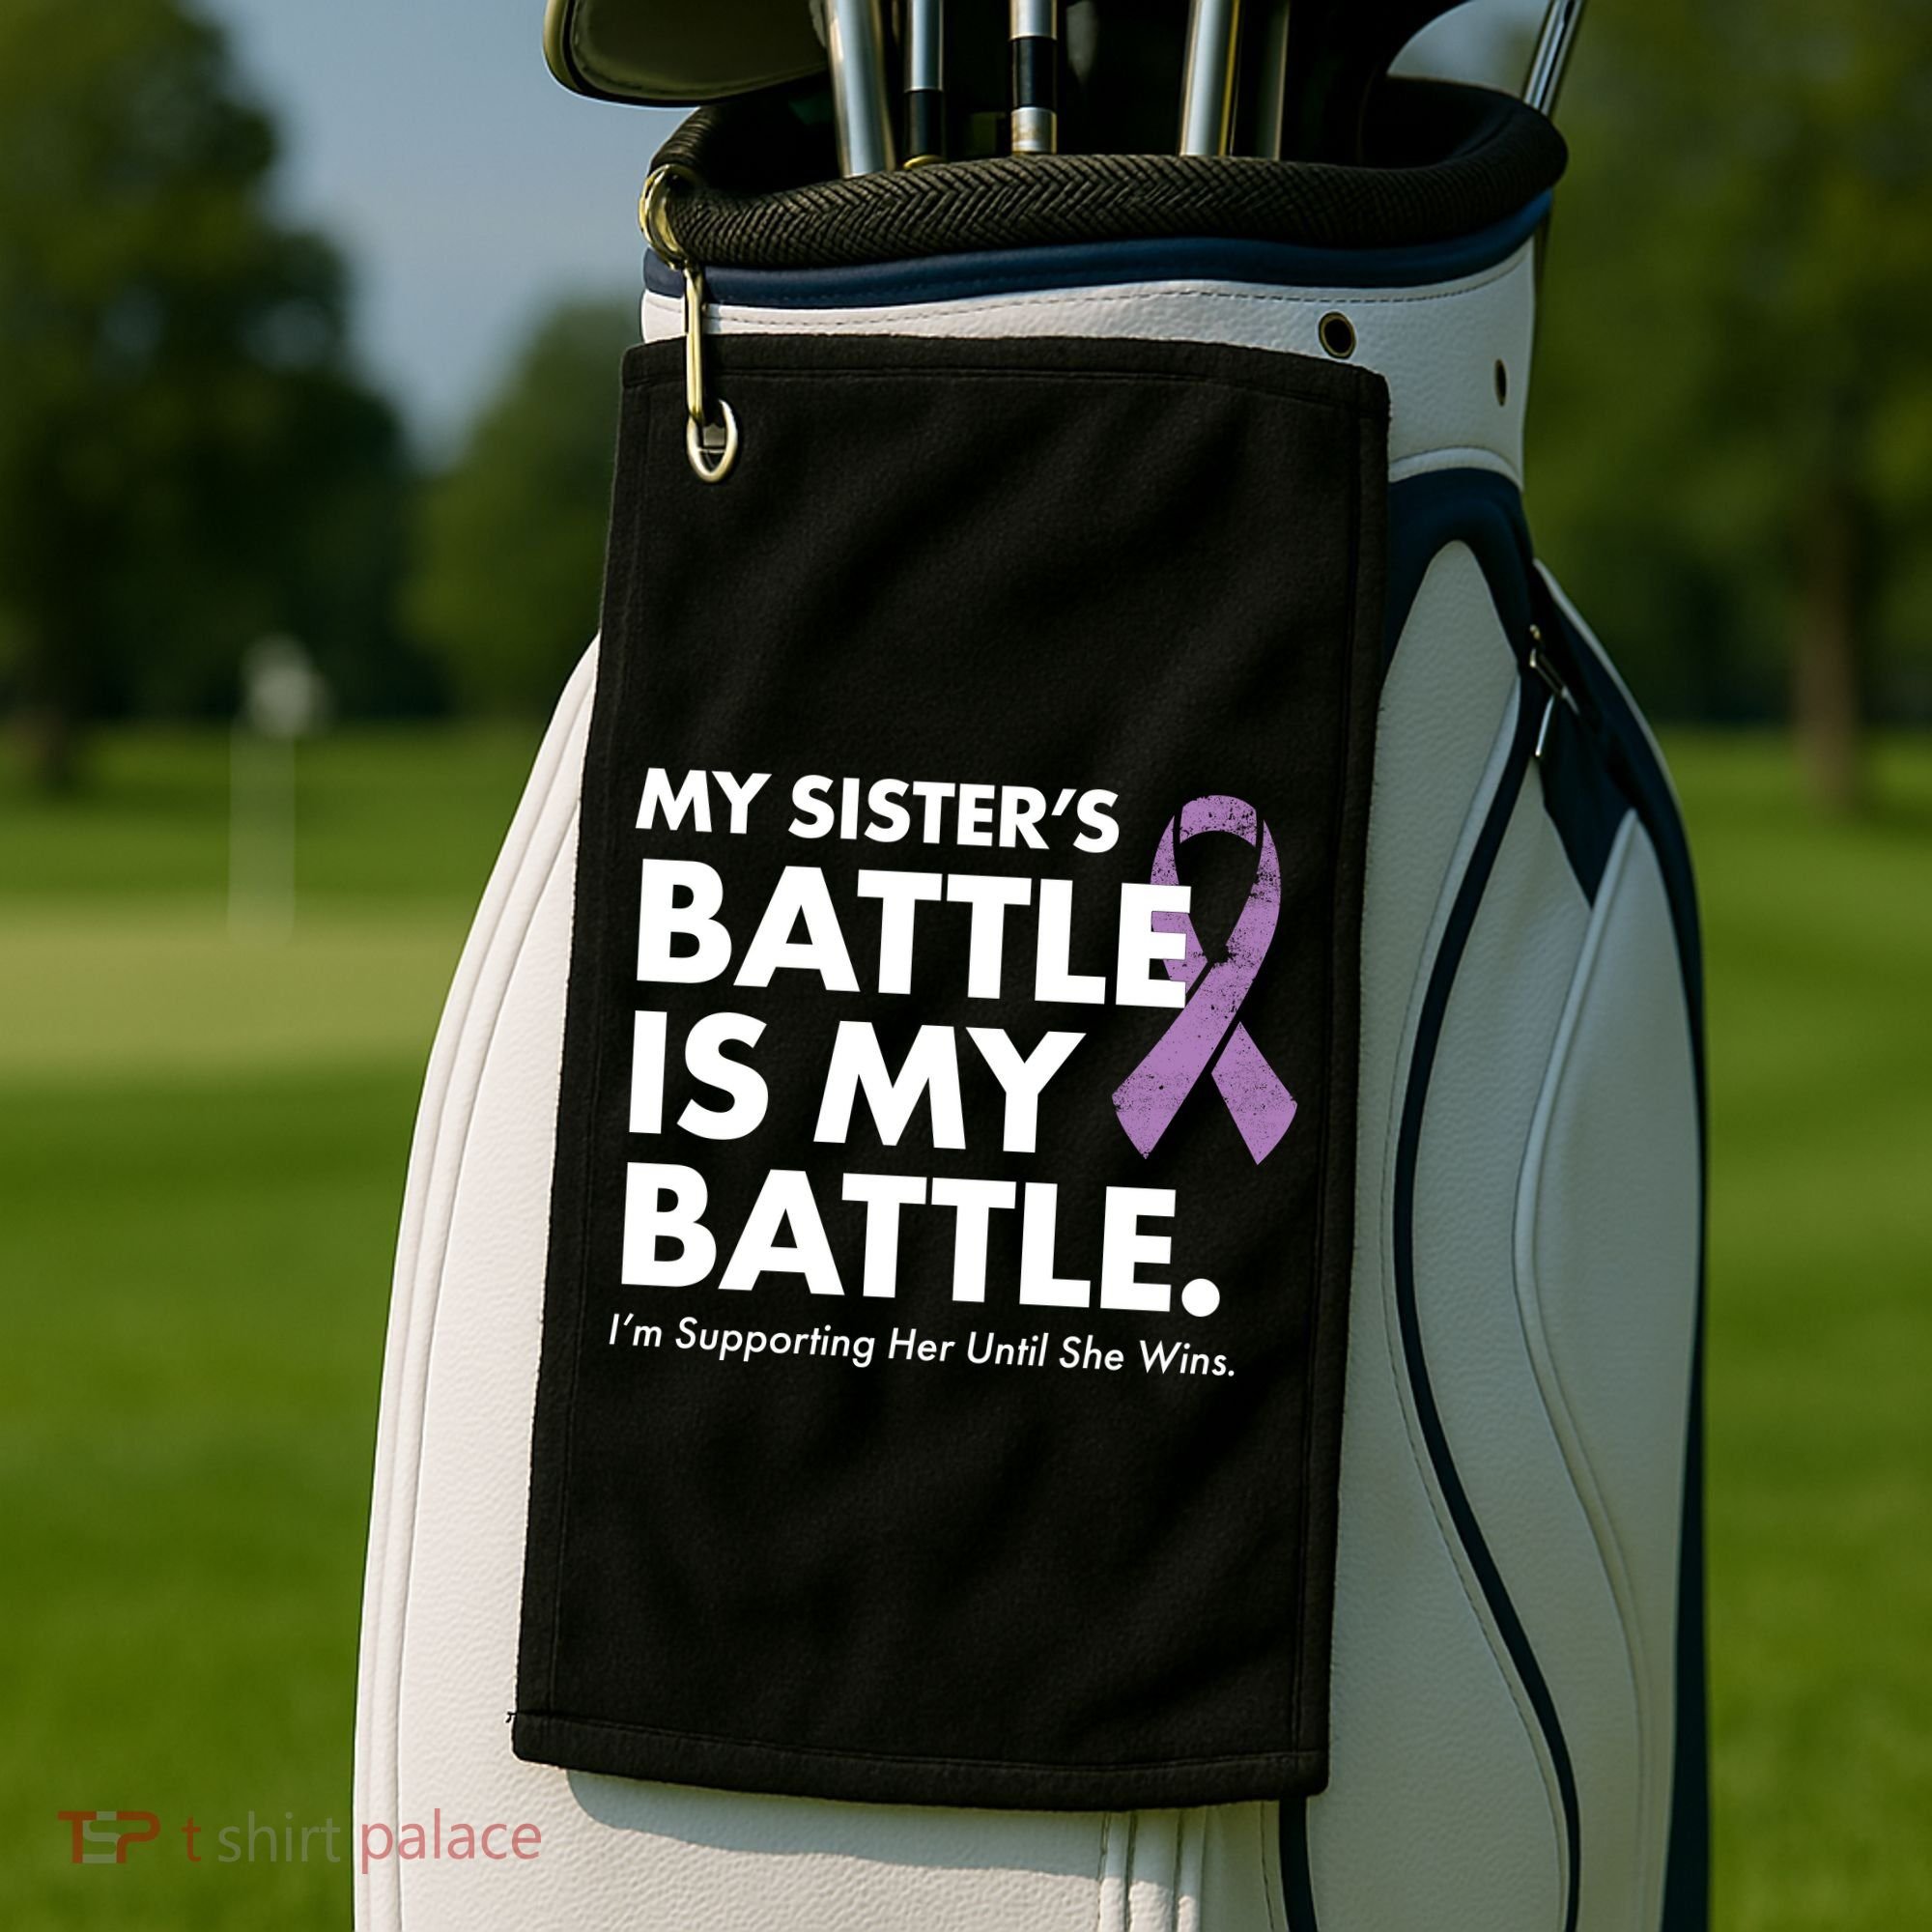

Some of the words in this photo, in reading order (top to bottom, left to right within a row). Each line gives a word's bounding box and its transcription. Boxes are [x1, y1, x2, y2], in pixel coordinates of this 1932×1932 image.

[635, 767, 772, 835] MY
[787, 774, 1120, 854] SISTER'S
[636, 858, 1192, 1009] BATTLE
[629, 1009, 769, 1141] IS
[812, 1020, 1087, 1153] MY
[621, 1161, 1221, 1318] BATTLE.
[609, 1313, 663, 1348] I'm
[675, 1316, 875, 1368] Supporting
[888, 1327, 956, 1362] Her
[967, 1331, 1049, 1367] Until
[1059, 1334, 1124, 1371] She
[1139, 1340, 1235, 1377] Wins.
